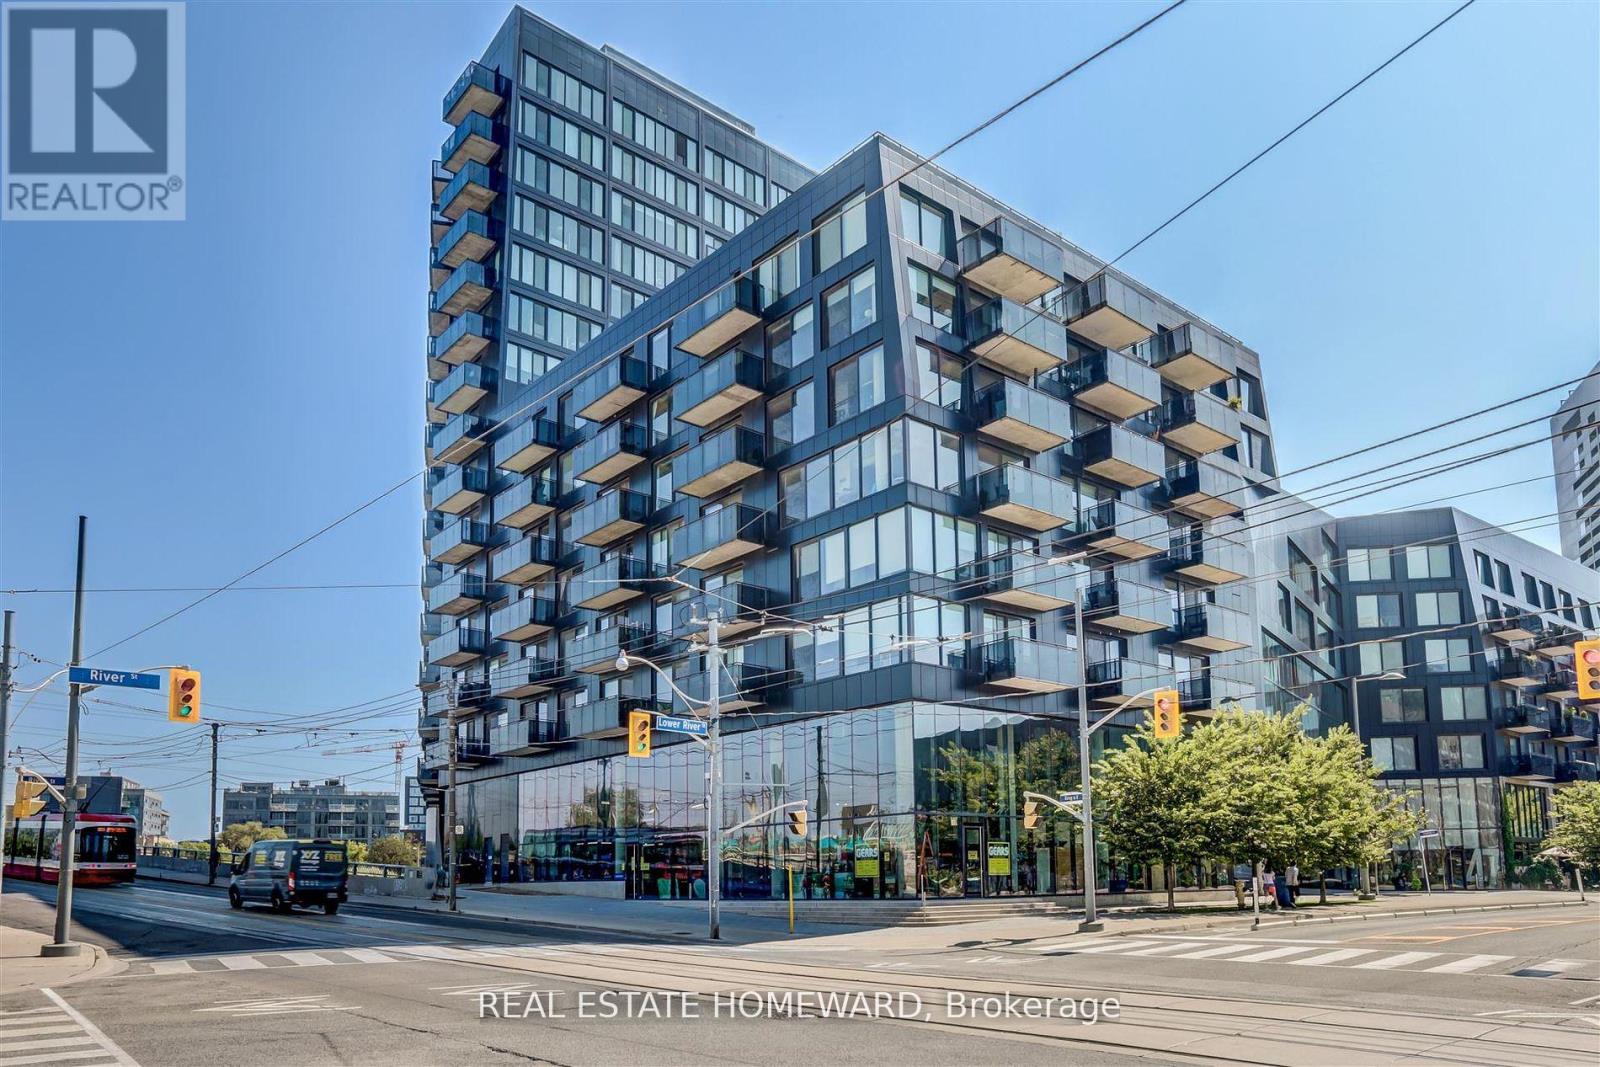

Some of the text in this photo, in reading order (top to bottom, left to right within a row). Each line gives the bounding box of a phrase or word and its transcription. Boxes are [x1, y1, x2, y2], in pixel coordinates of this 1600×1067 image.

[90, 669, 126, 683] River
[658, 717, 680, 728] Lower
[682, 720, 701, 731] River
[856, 847, 879, 858] GEARS
[988, 846, 1009, 856] GEARS
